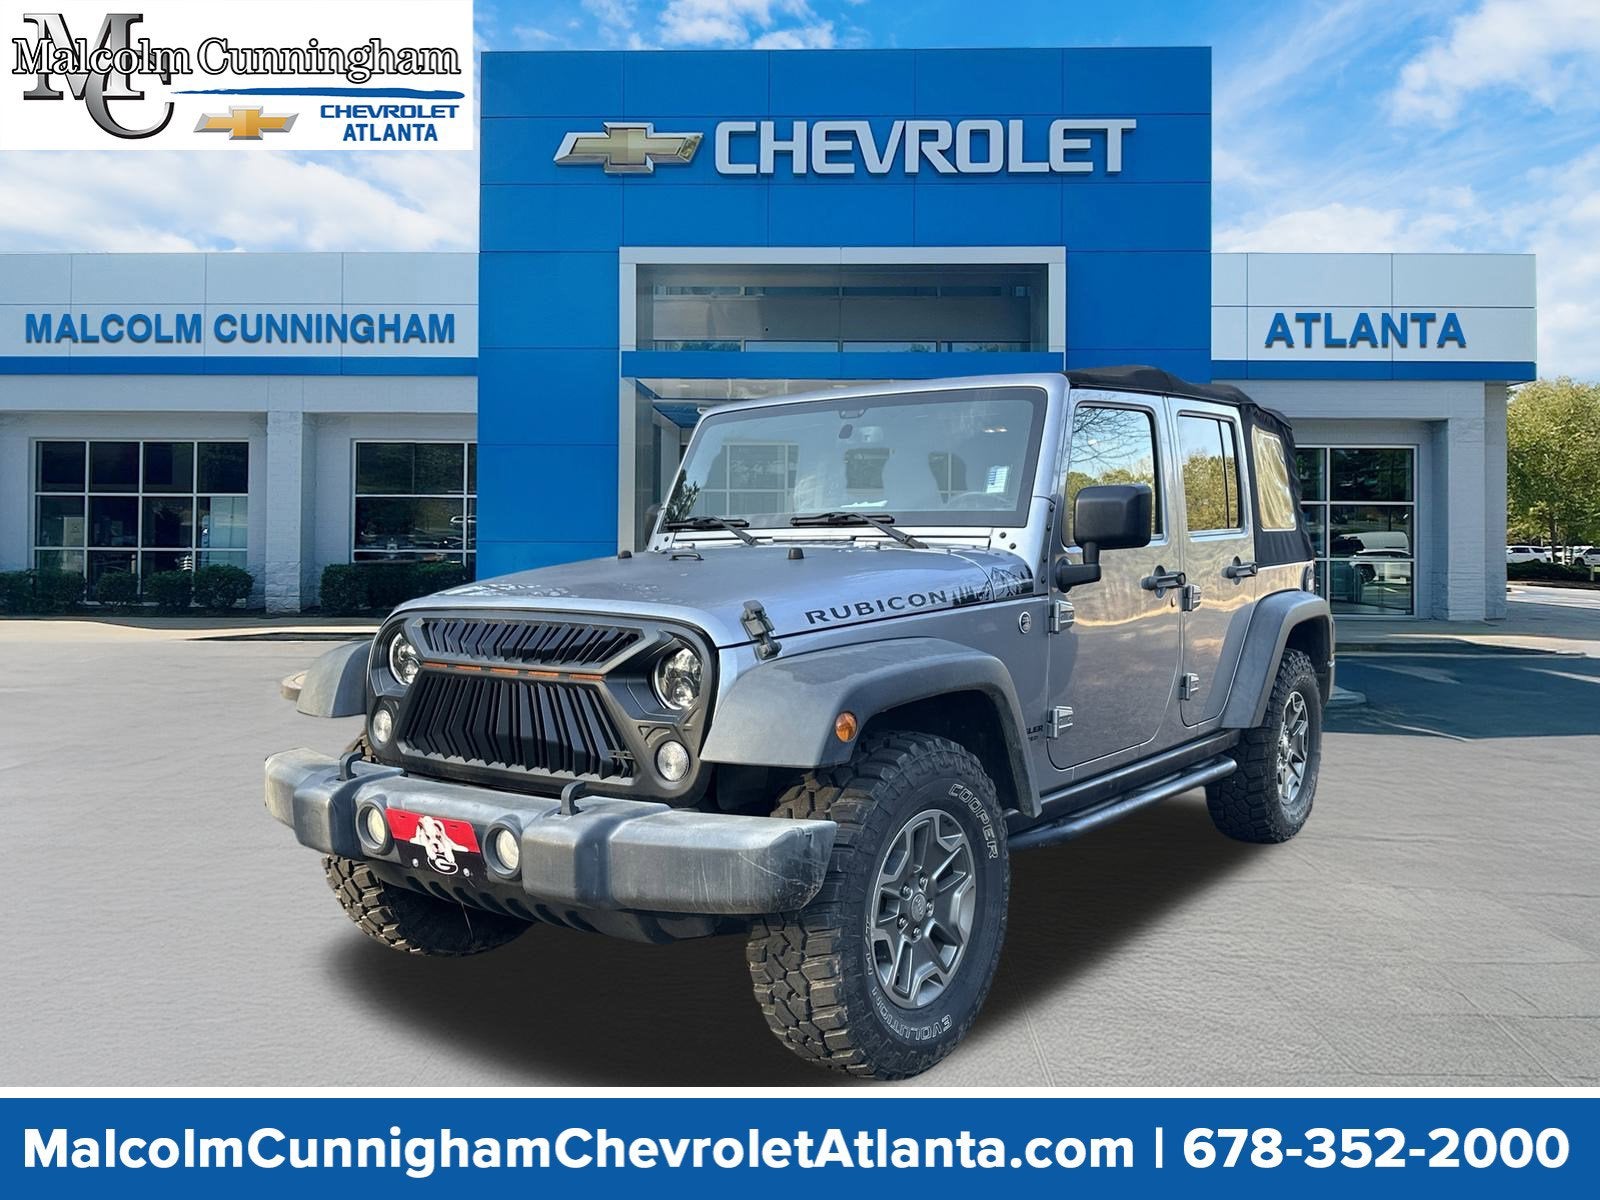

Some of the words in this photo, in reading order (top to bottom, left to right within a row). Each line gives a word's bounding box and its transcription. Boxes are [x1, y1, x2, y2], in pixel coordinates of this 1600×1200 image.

[715, 119, 1137, 174] CHEVROLET
[25, 313, 202, 343] MALCOLM
[213, 313, 455, 343] CUNNINGHAM
[1264, 312, 1467, 348] ATLANTA
[804, 590, 948, 624] RUBICON
[948, 783, 998, 859] COOPER
[871, 985, 953, 1041] EVOLUTION
